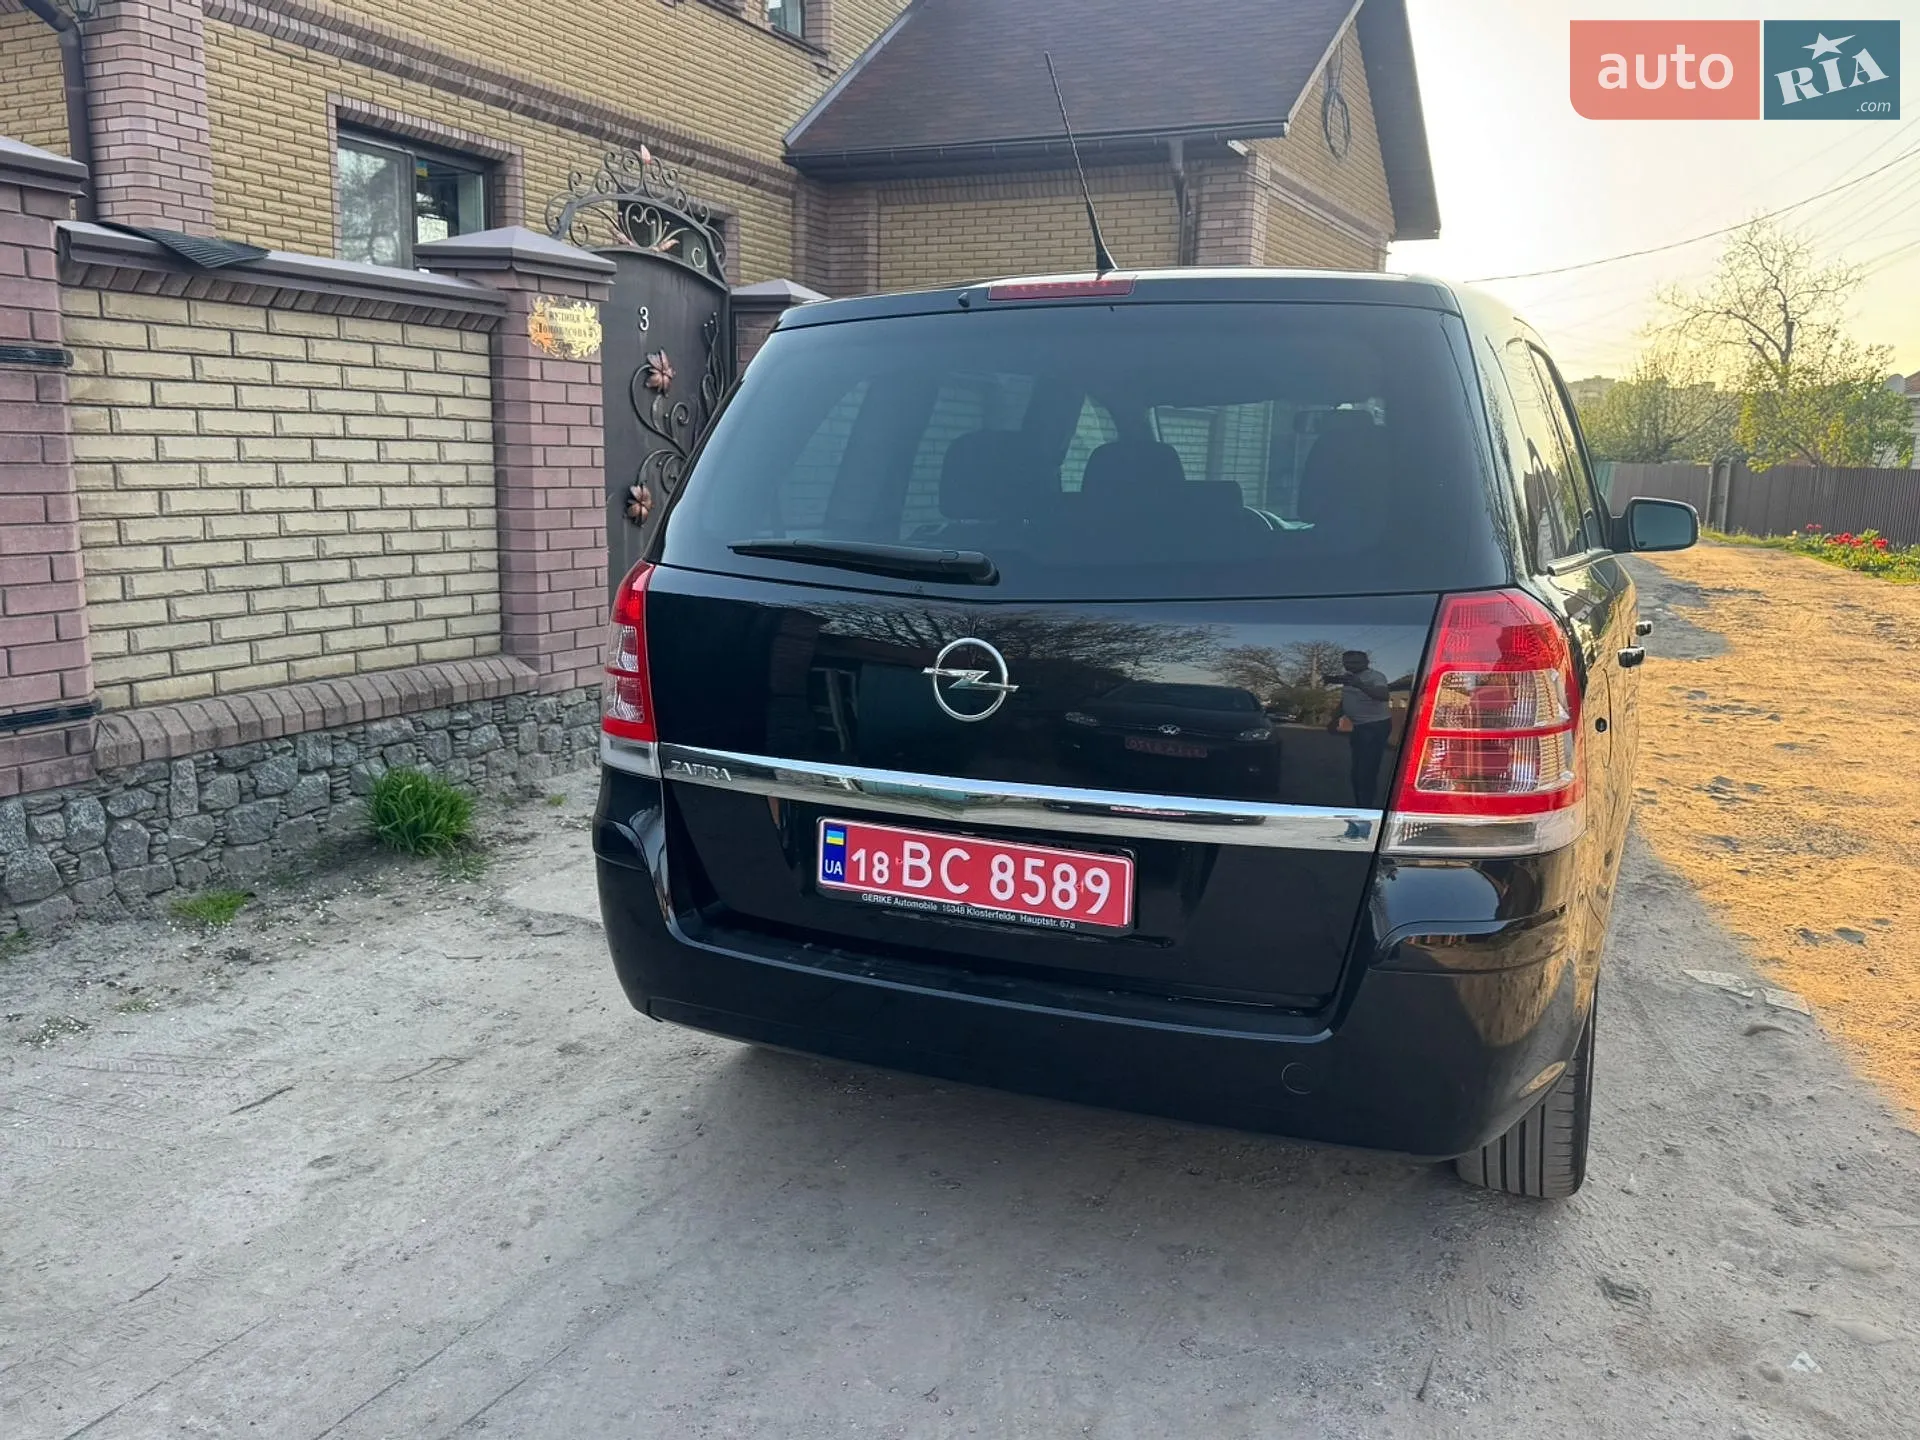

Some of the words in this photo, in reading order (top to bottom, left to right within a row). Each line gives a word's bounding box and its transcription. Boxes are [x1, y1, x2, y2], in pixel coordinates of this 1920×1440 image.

[639, 306, 649, 331] 3
[825, 859, 843, 876] UA
[851, 848, 890, 884] 18
[902, 840, 971, 894] BC
[989, 854, 1111, 914] 8589
[861, 893, 892, 904] GERIKE
[893, 898, 938, 911] Automobile
[966, 907, 1016, 921] Klosterfelde
